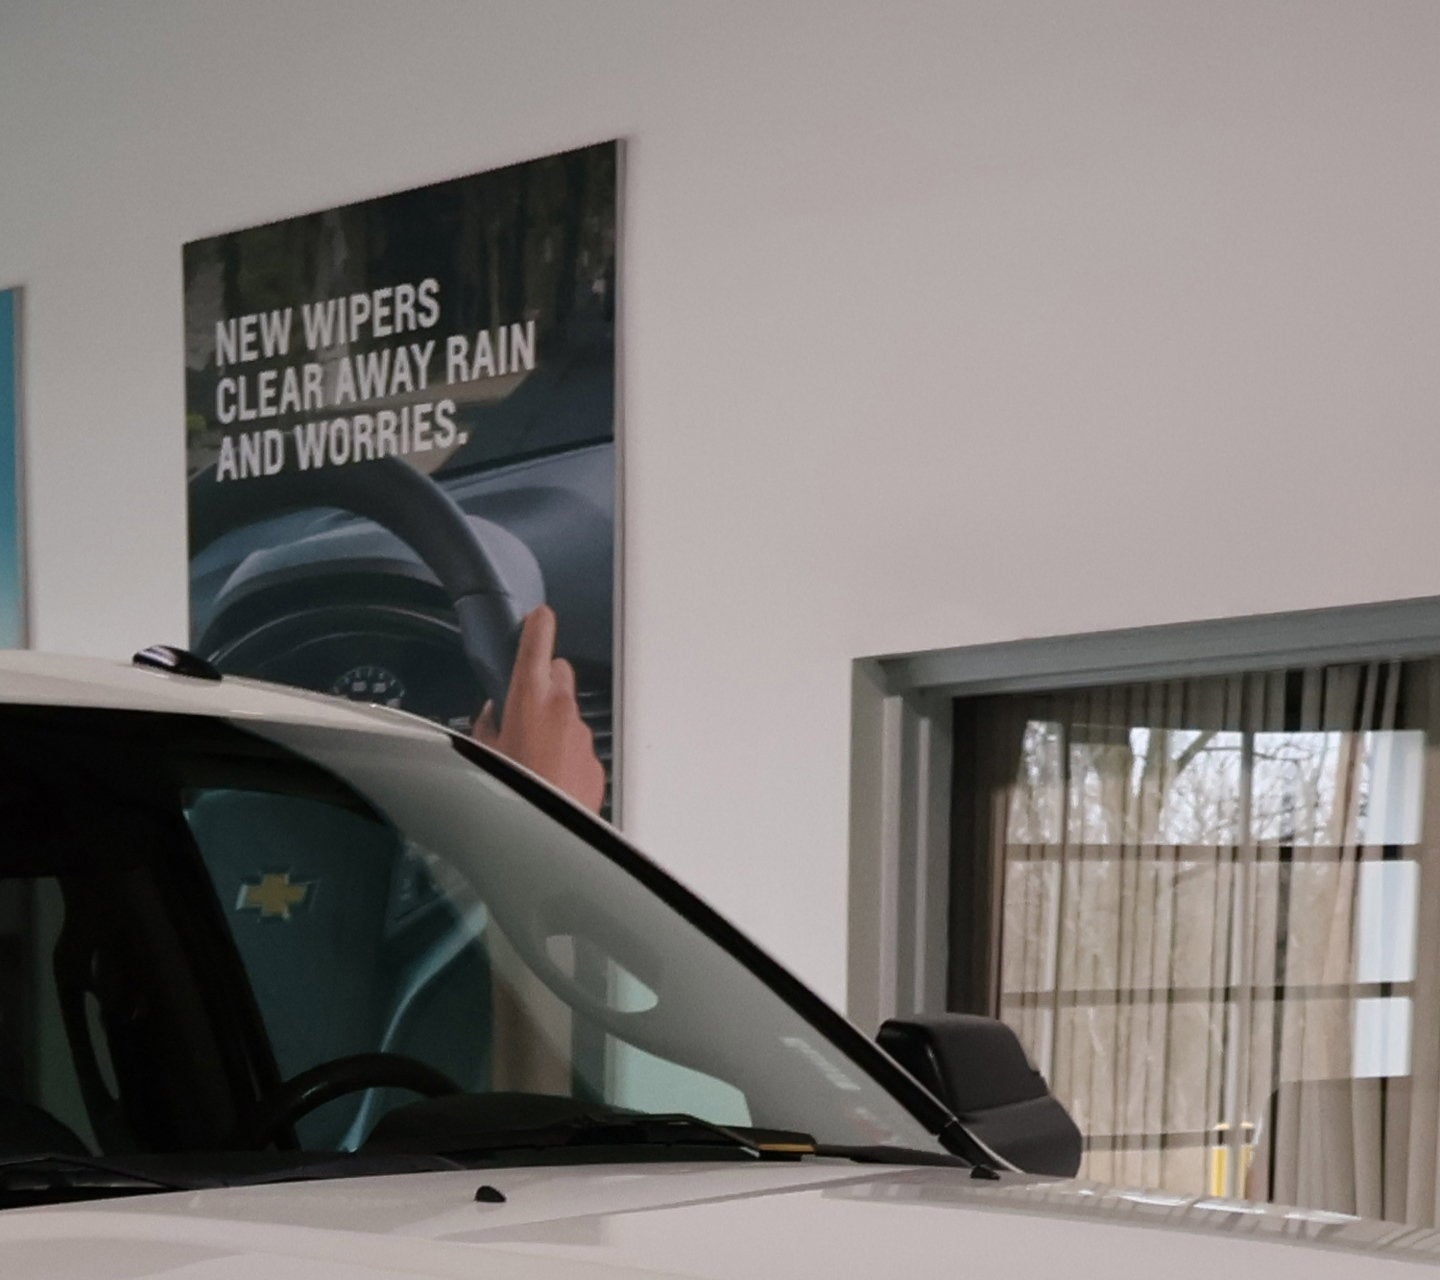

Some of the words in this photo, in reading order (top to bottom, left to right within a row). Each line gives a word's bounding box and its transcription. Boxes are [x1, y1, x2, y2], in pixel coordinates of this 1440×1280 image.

[217, 307, 293, 366] NEW
[302, 278, 440, 350] WIPERS
[217, 362, 324, 424] CLEAR
[335, 343, 432, 407] AWAY
[446, 320, 536, 384] RAIN
[217, 429, 282, 482] AND
[294, 400, 468, 472] WORRIES.
